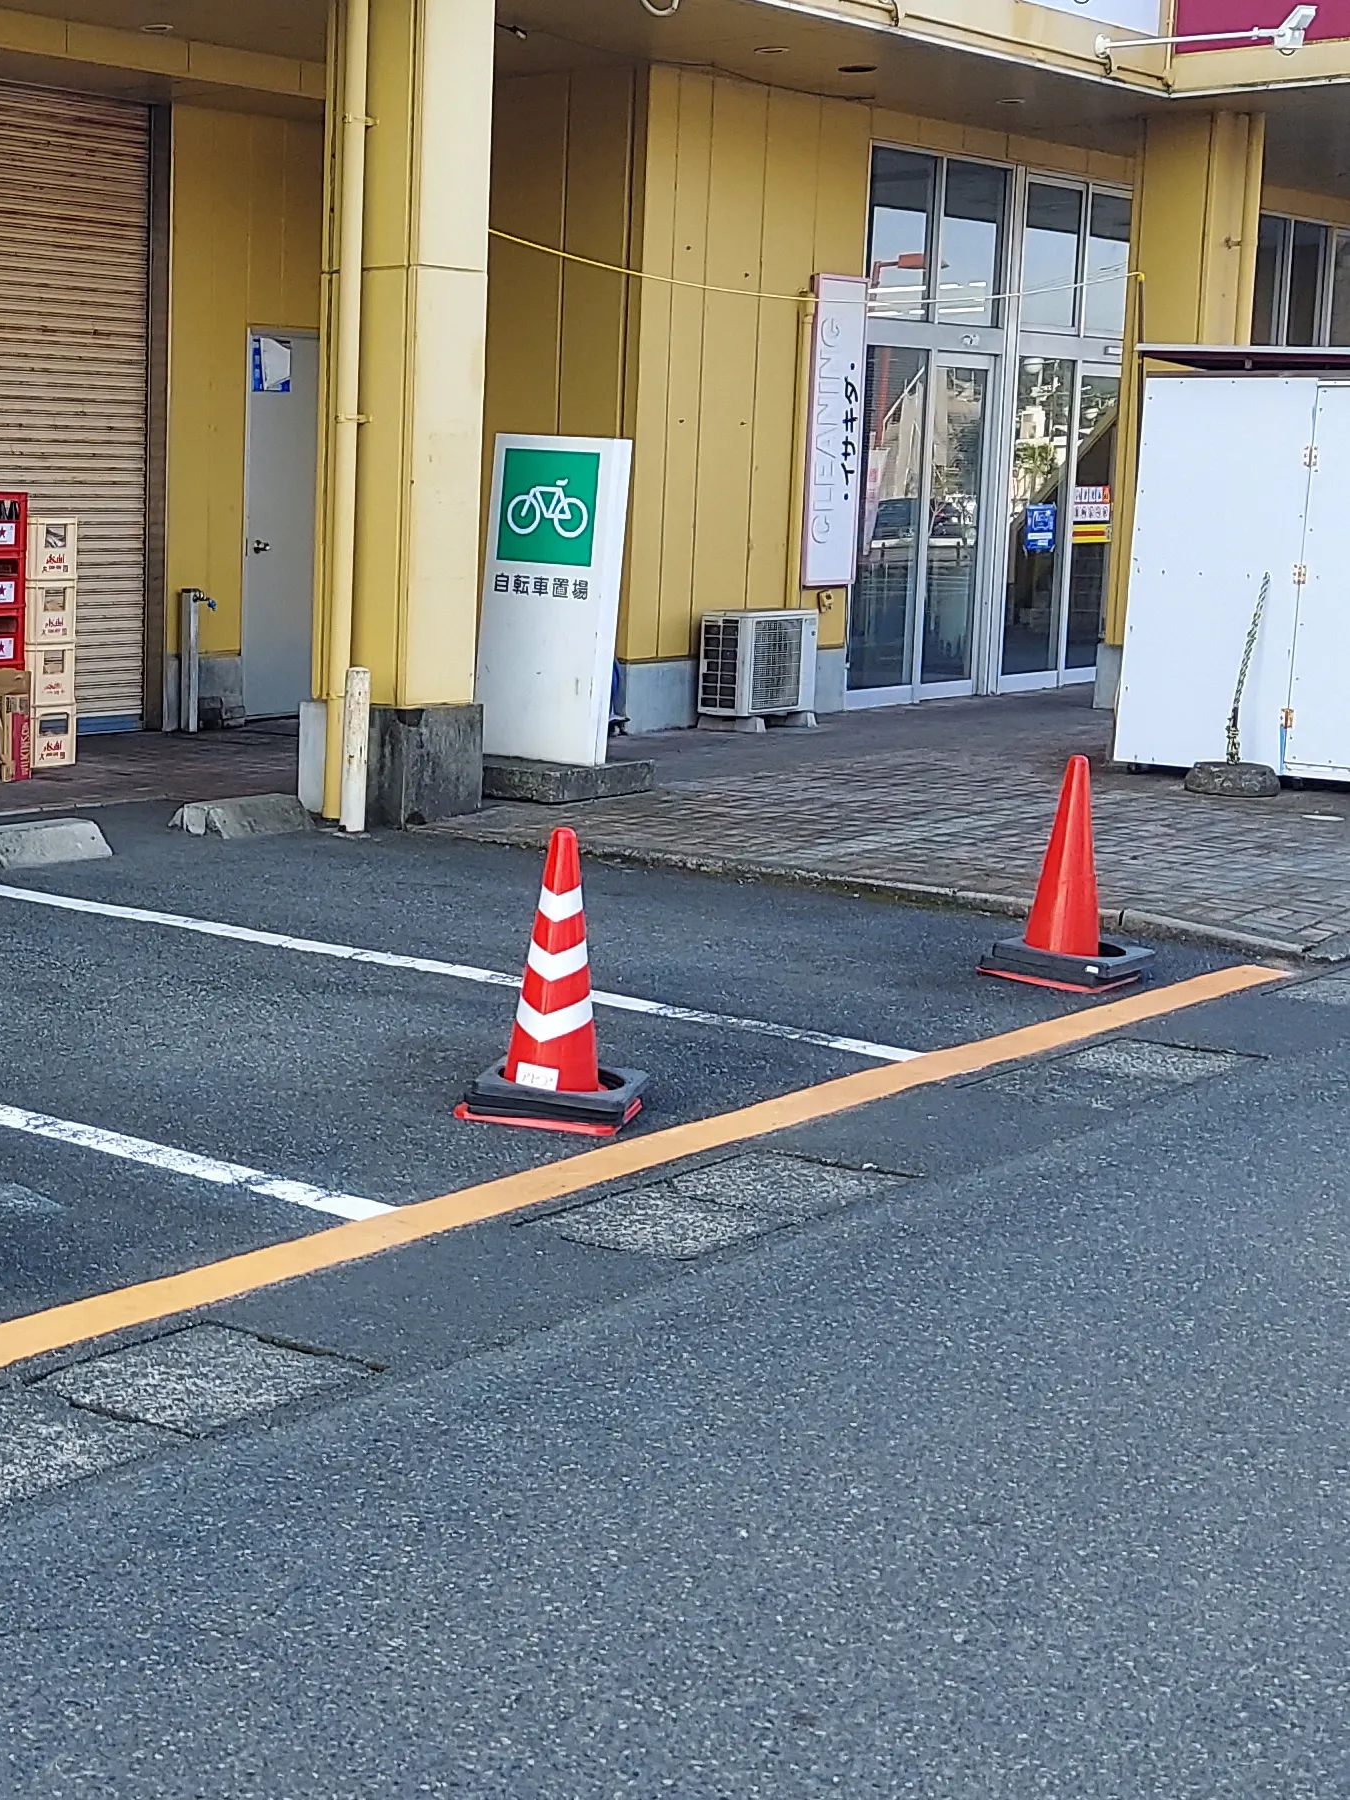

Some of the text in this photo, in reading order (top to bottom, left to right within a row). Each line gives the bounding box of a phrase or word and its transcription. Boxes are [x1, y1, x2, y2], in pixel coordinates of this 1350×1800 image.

[811, 317, 840, 544] CLEANING
[493, 572, 589, 601] 自転車置場
